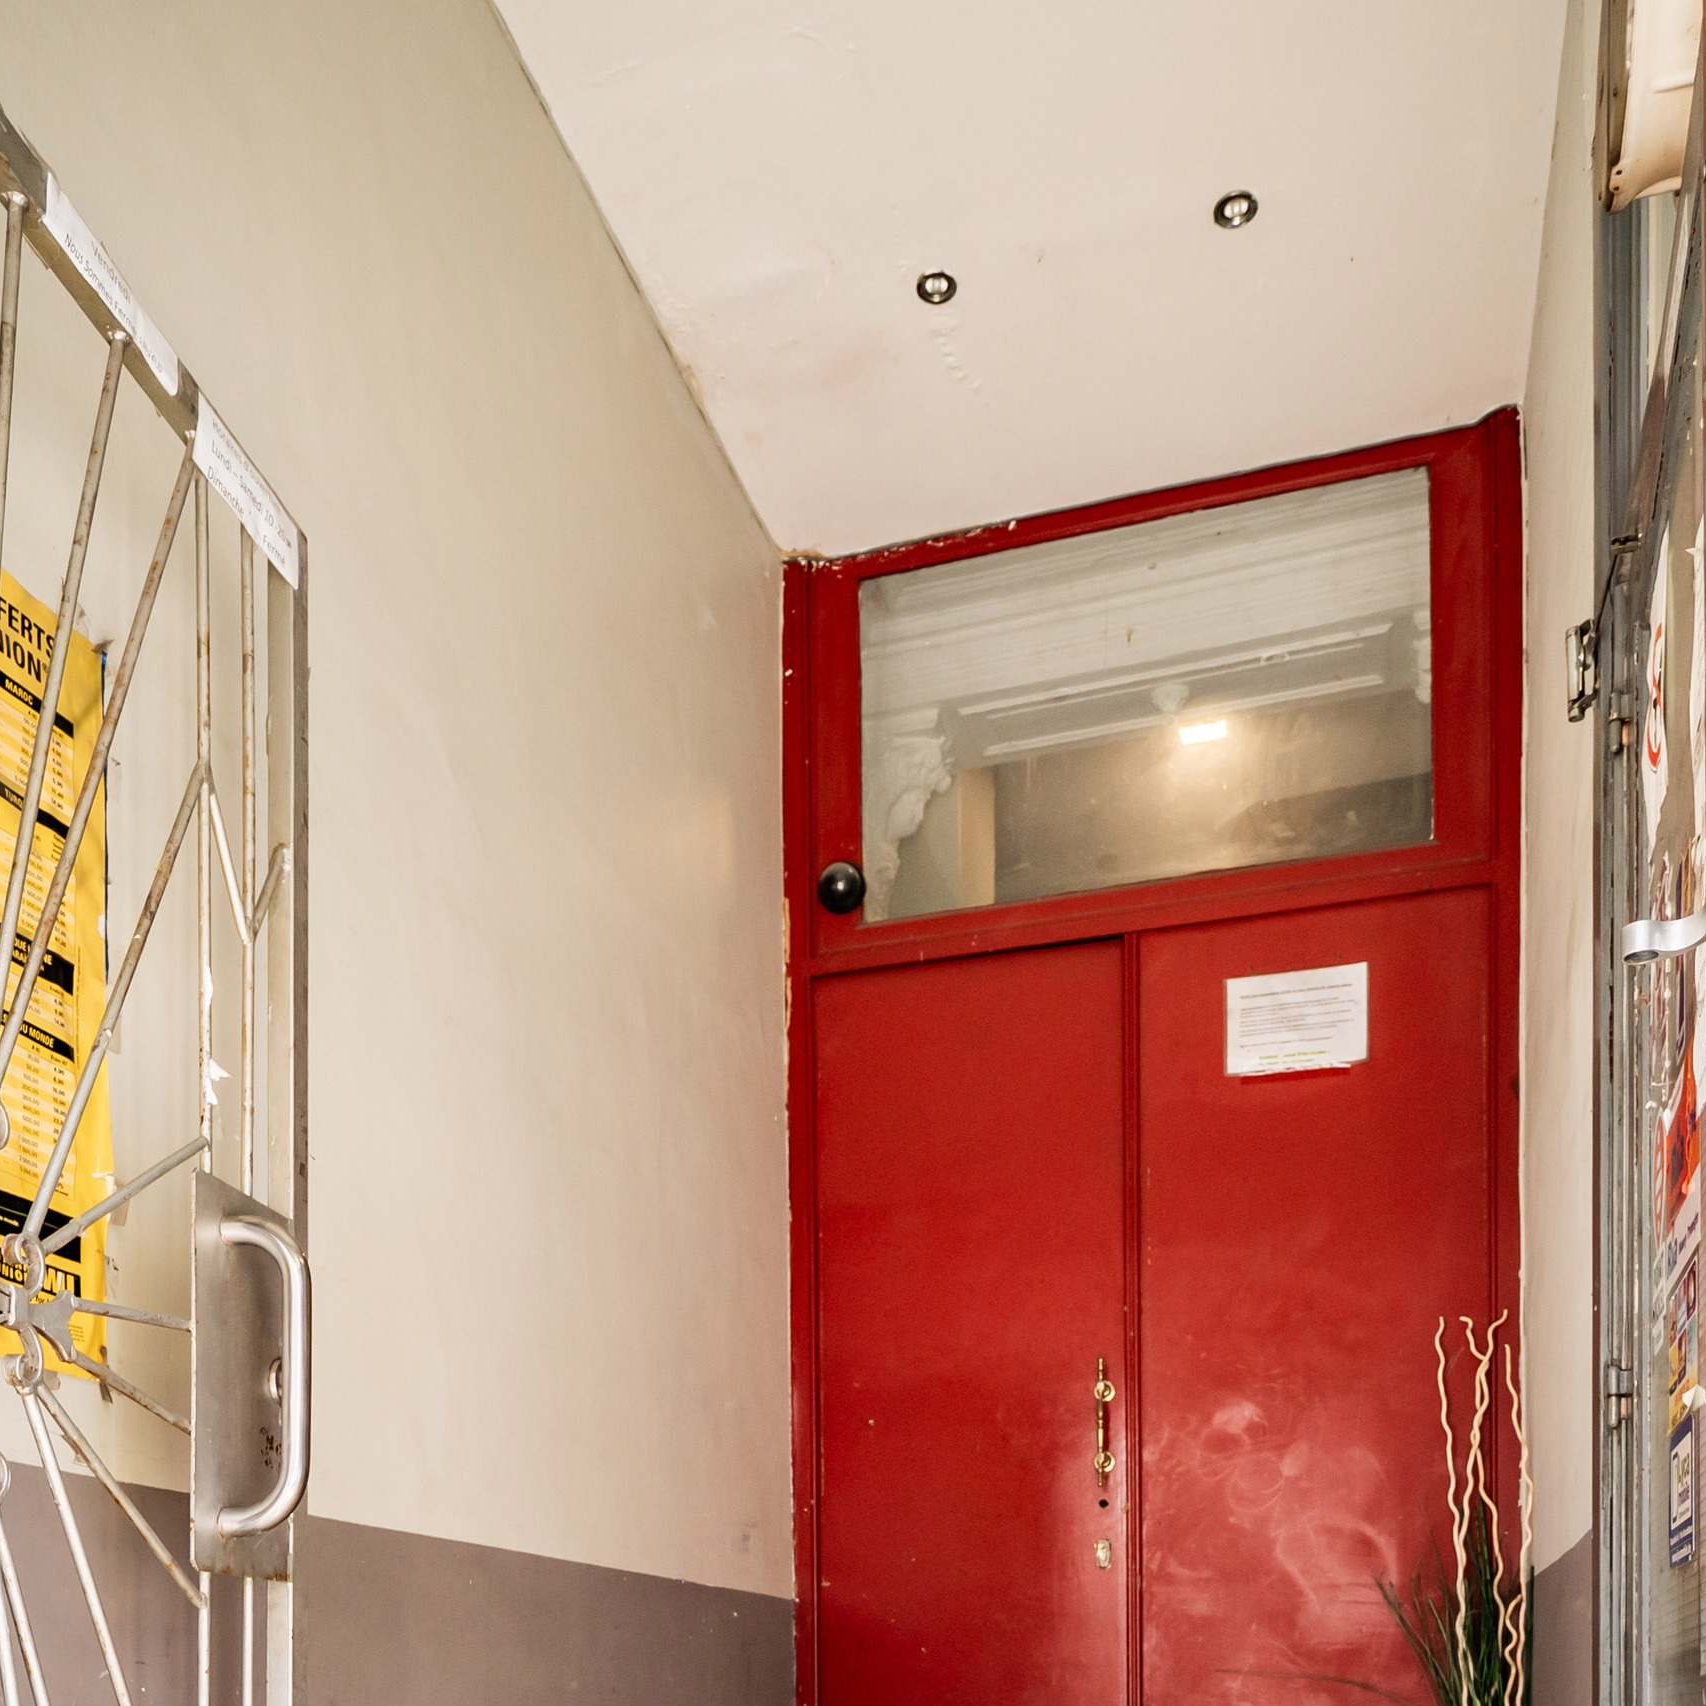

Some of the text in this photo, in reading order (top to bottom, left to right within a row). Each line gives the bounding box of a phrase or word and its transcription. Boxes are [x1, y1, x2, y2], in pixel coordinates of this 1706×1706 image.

[65, 233, 113, 305] Nous Sommes
[91, 240, 132, 304] Vendredi
[207, 465, 287, 568] Dimanche Fermé
[211, 439, 274, 526] Lundi Samedi 10
[5, 679, 33, 706] MAROC
[29, 1026, 54, 1048] MONDE
